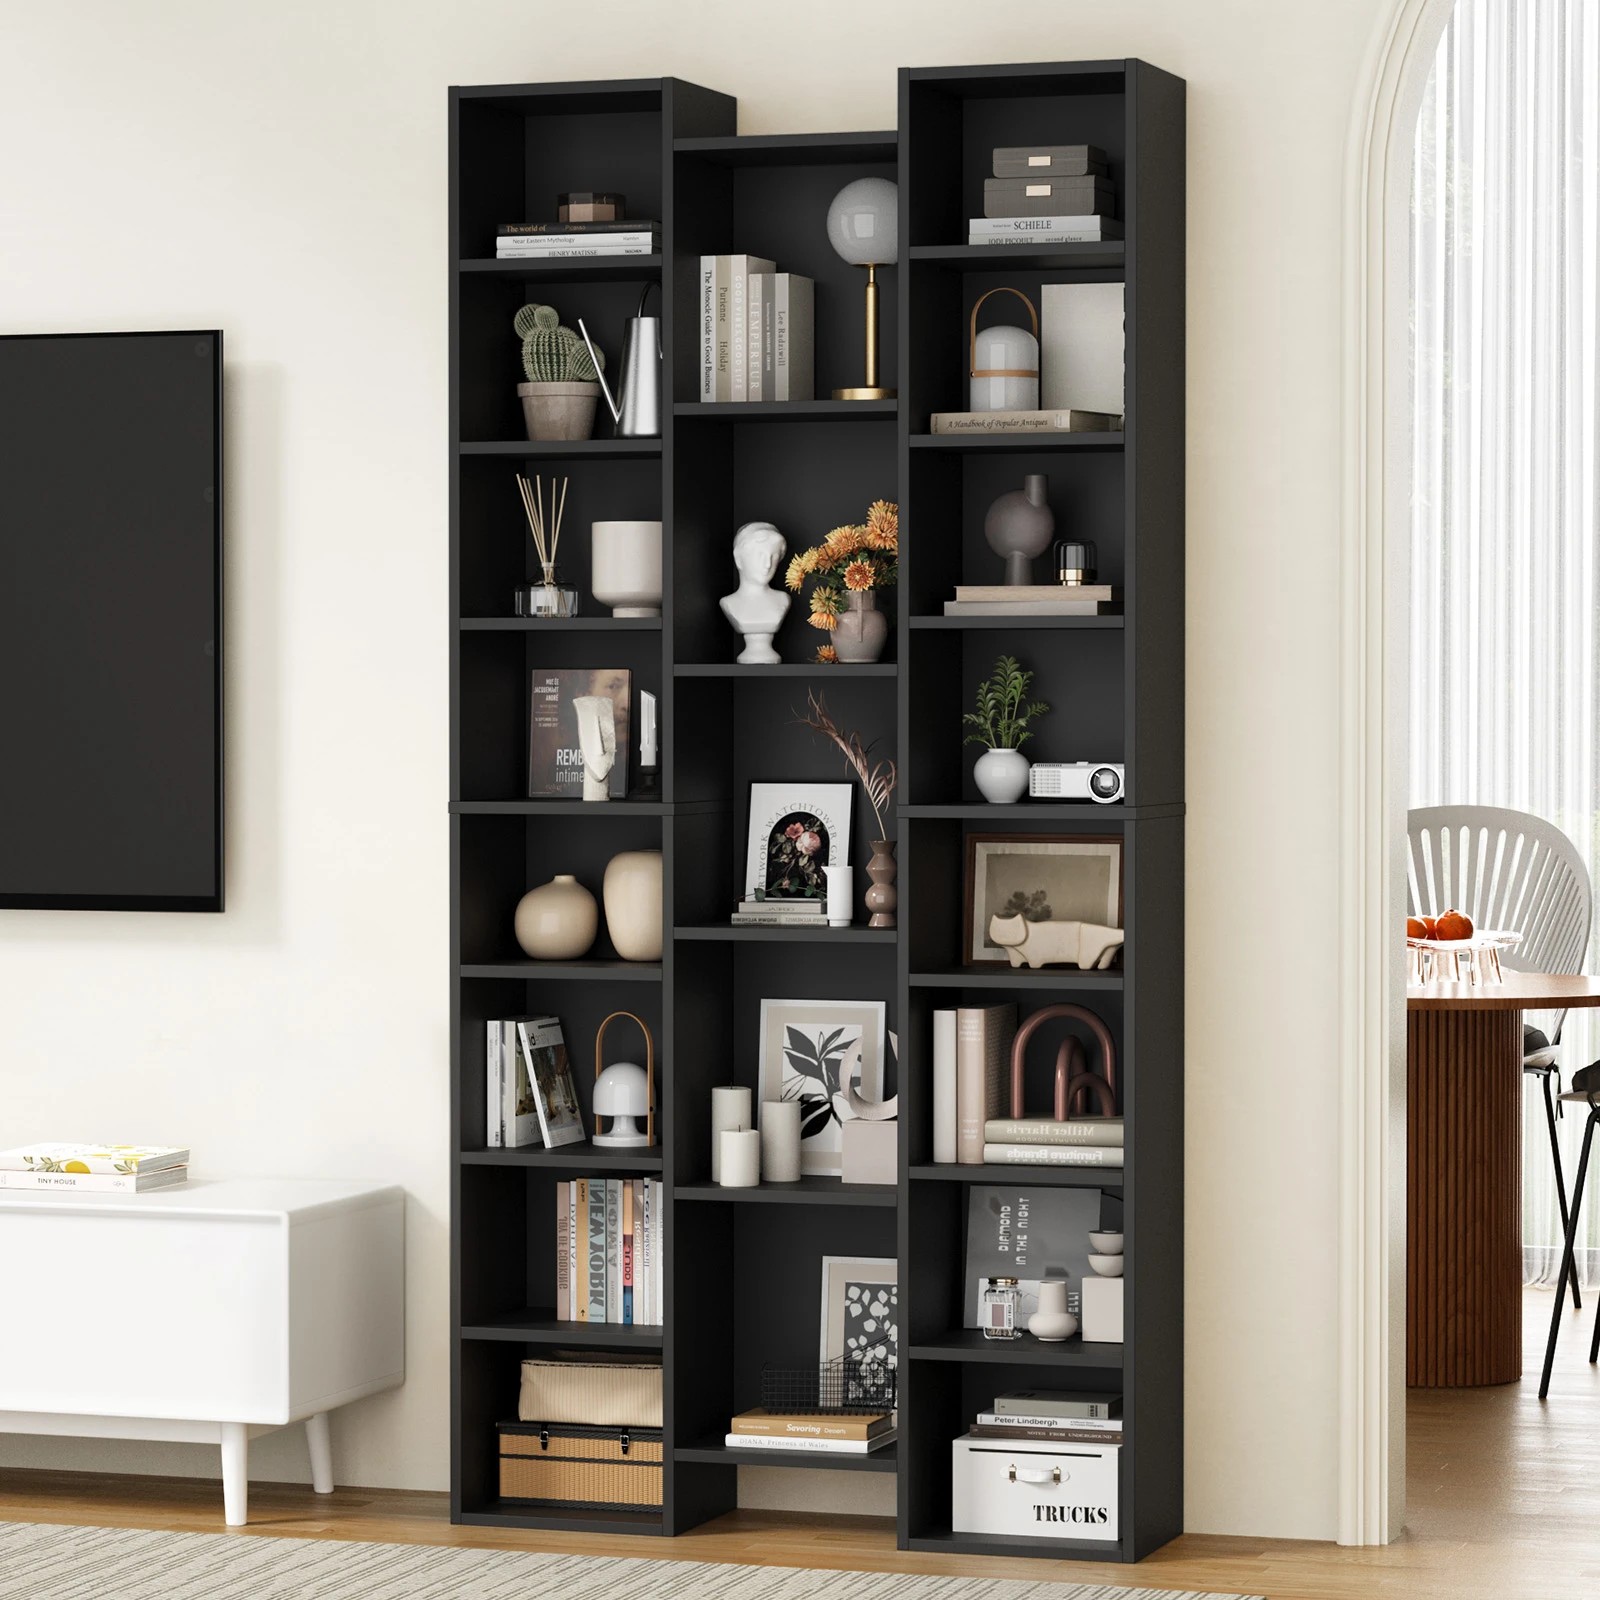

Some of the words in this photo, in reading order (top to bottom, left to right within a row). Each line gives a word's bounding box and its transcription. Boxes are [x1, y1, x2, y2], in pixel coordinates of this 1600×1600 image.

[506, 224, 518, 232] The
[1014, 220, 1052, 230] SCHIELE
[720, 287, 728, 322] Purienne
[750, 302, 759, 389] LEMPEREUR
[718, 341, 728, 372] Holiday
[954, 419, 986, 428] Handbook
[986, 419, 994, 429] of
[995, 419, 1019, 429] Popular
[1020, 419, 1048, 428] Antiques
[556, 749, 584, 765] REMB
[556, 768, 584, 782] intime
[758, 834, 768, 888] RTWORK
[766, 802, 837, 839] WATCHTOWER
[1018, 1198, 1029, 1228] NIGHT
[998, 1205, 1011, 1251] DIAMOND
[1016, 1234, 1028, 1252] THE
[1016, 1255, 1027, 1265] IN
[786, 1424, 821, 1435] Savoring
[1017, 1417, 1058, 1427] Lindbergh
[1033, 1505, 1108, 1524] TRUCKS
